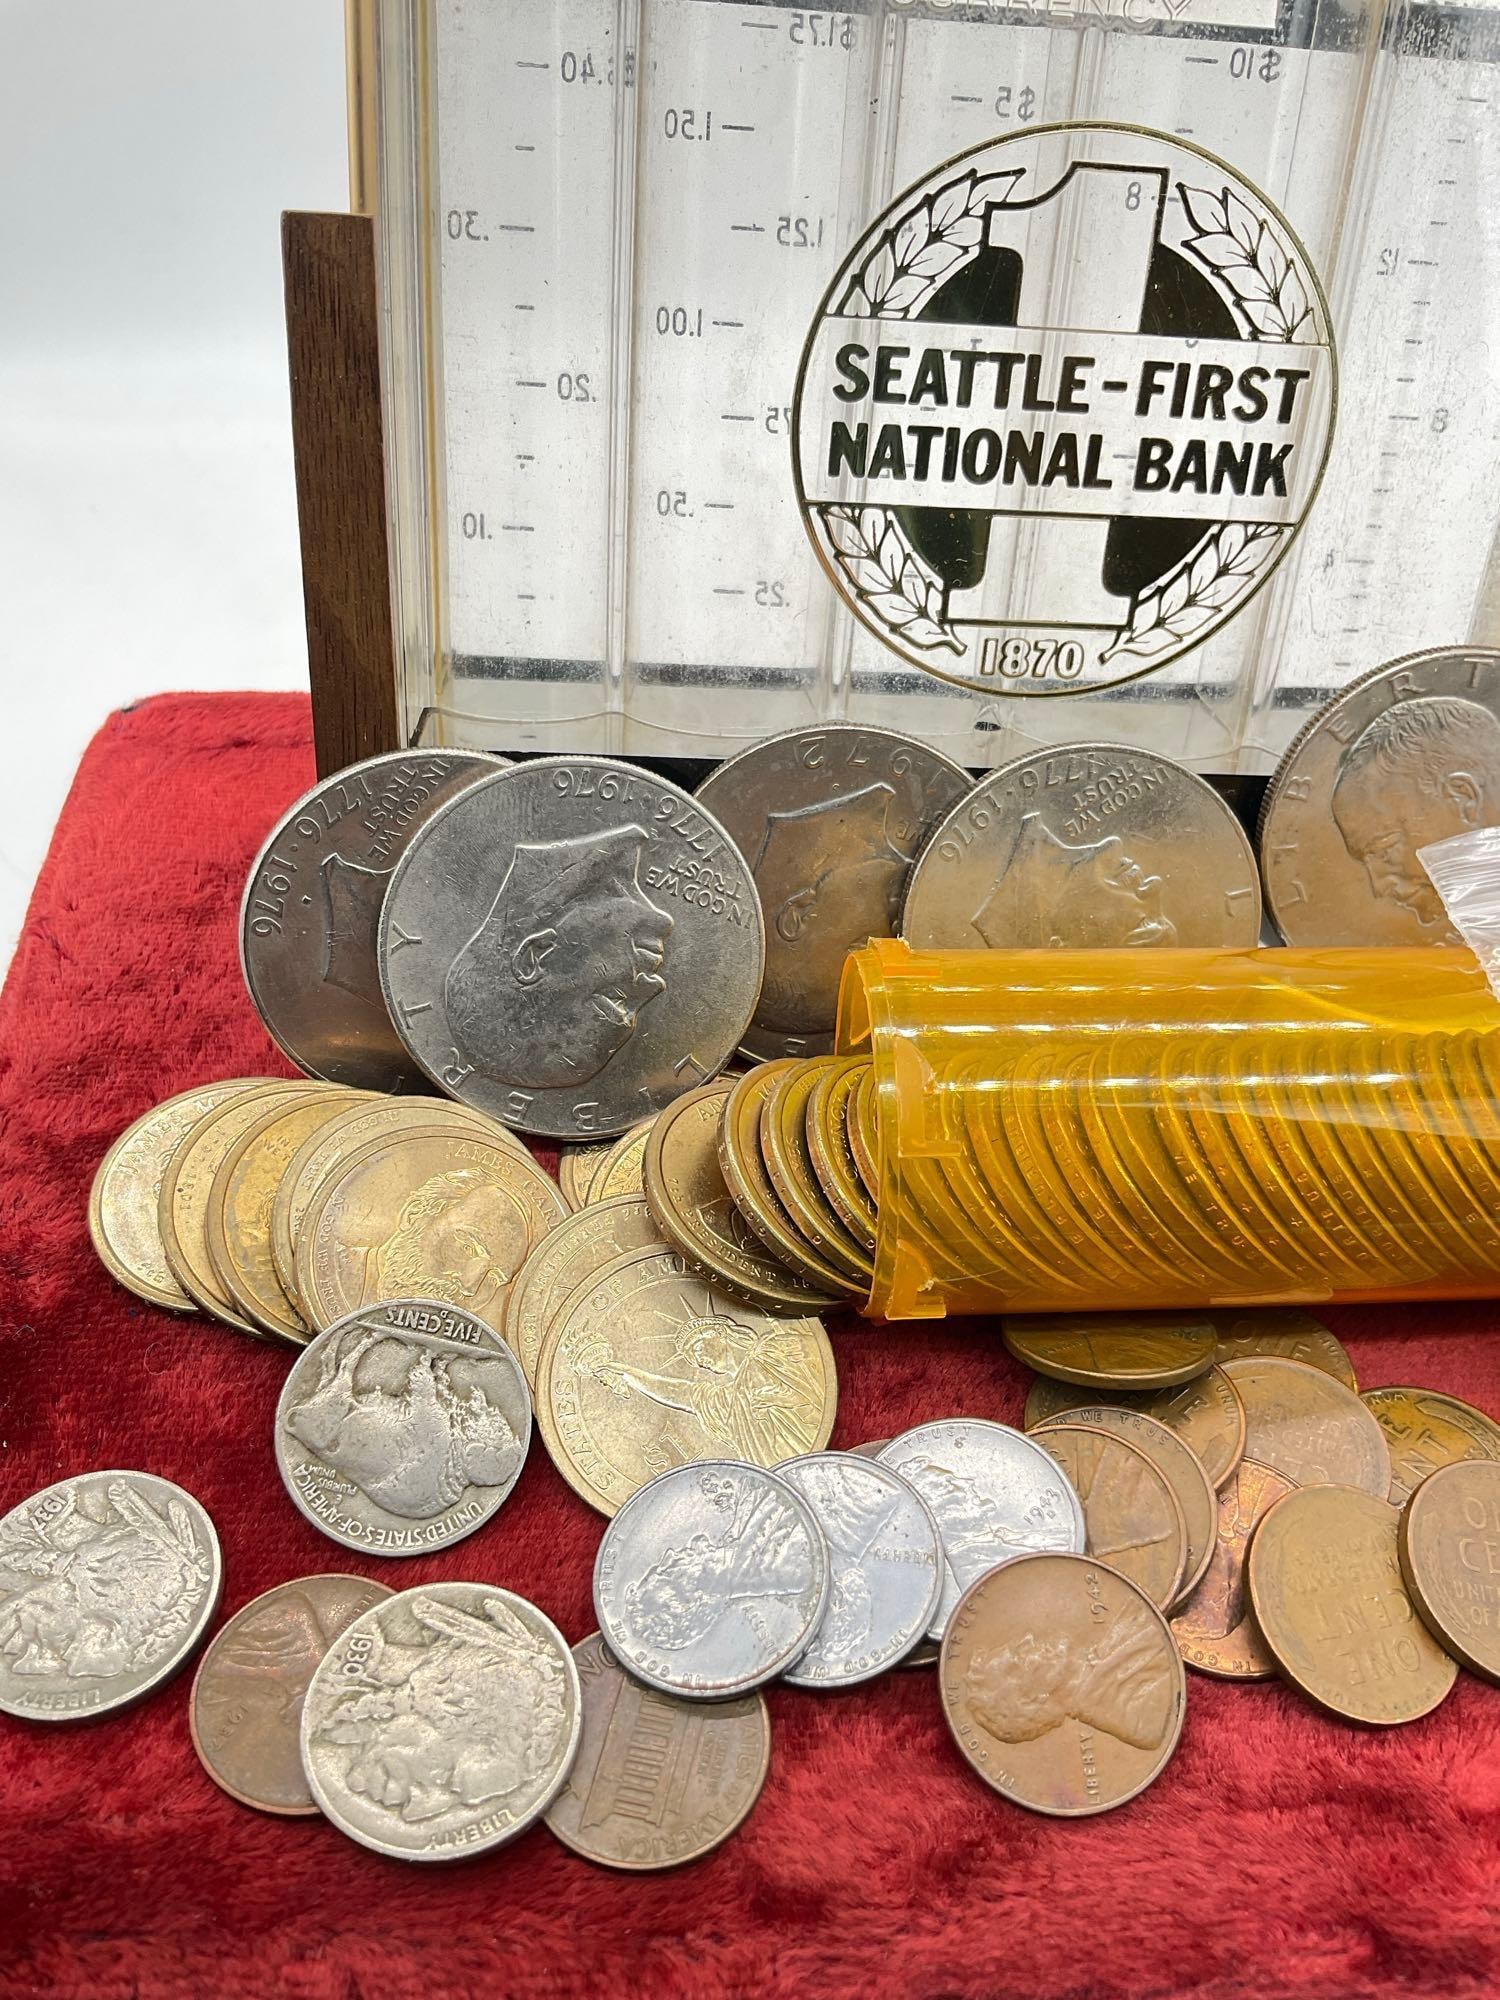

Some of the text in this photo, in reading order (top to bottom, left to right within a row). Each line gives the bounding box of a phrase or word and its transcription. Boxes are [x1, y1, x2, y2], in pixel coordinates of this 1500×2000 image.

[827, 421, 1294, 498] NATIONAL BANK
[981, 637, 1085, 678] 1870
[363, 764, 419, 837] TRUST
[368, 757, 451, 862] IN GOD WE
[1063, 764, 1170, 840] IN GOD WE
[645, 866, 681, 898] WE
[668, 854, 744, 901] TRUST
[681, 883, 727, 916] GOD
[116, 1111, 184, 1176] JAMES
[447, 1140, 559, 1232] JAMES GAR
[681, 1207, 777, 1284] PRESIDENT
[384, 1306, 483, 1345] FIVE CENTS
[555, 1378, 616, 1491] STATES
[590, 1276, 625, 1313] OF
[902, 1424, 973, 1450] TRUST
[1081, 1409, 1103, 1424] WE
[641, 1420, 704, 1474] $1
[30, 1491, 68, 1538] 1937
[293, 1463, 484, 1549] UNITED STATES OF AMERICA
[600, 1532, 624, 1604] TRUST
[947, 1584, 987, 1662] TRUST
[1084, 1570, 1110, 1625] 1942
[1311, 1588, 1415, 1644] CENT
[341, 1631, 373, 1678] 1930
[634, 1649, 671, 1679] GOD
[1338, 1635, 1422, 1686] ONE
[958, 1722, 989, 1764] GOD
[1078, 1731, 1101, 1804] LIBERTY
[425, 1808, 518, 1852] LIBERTY
